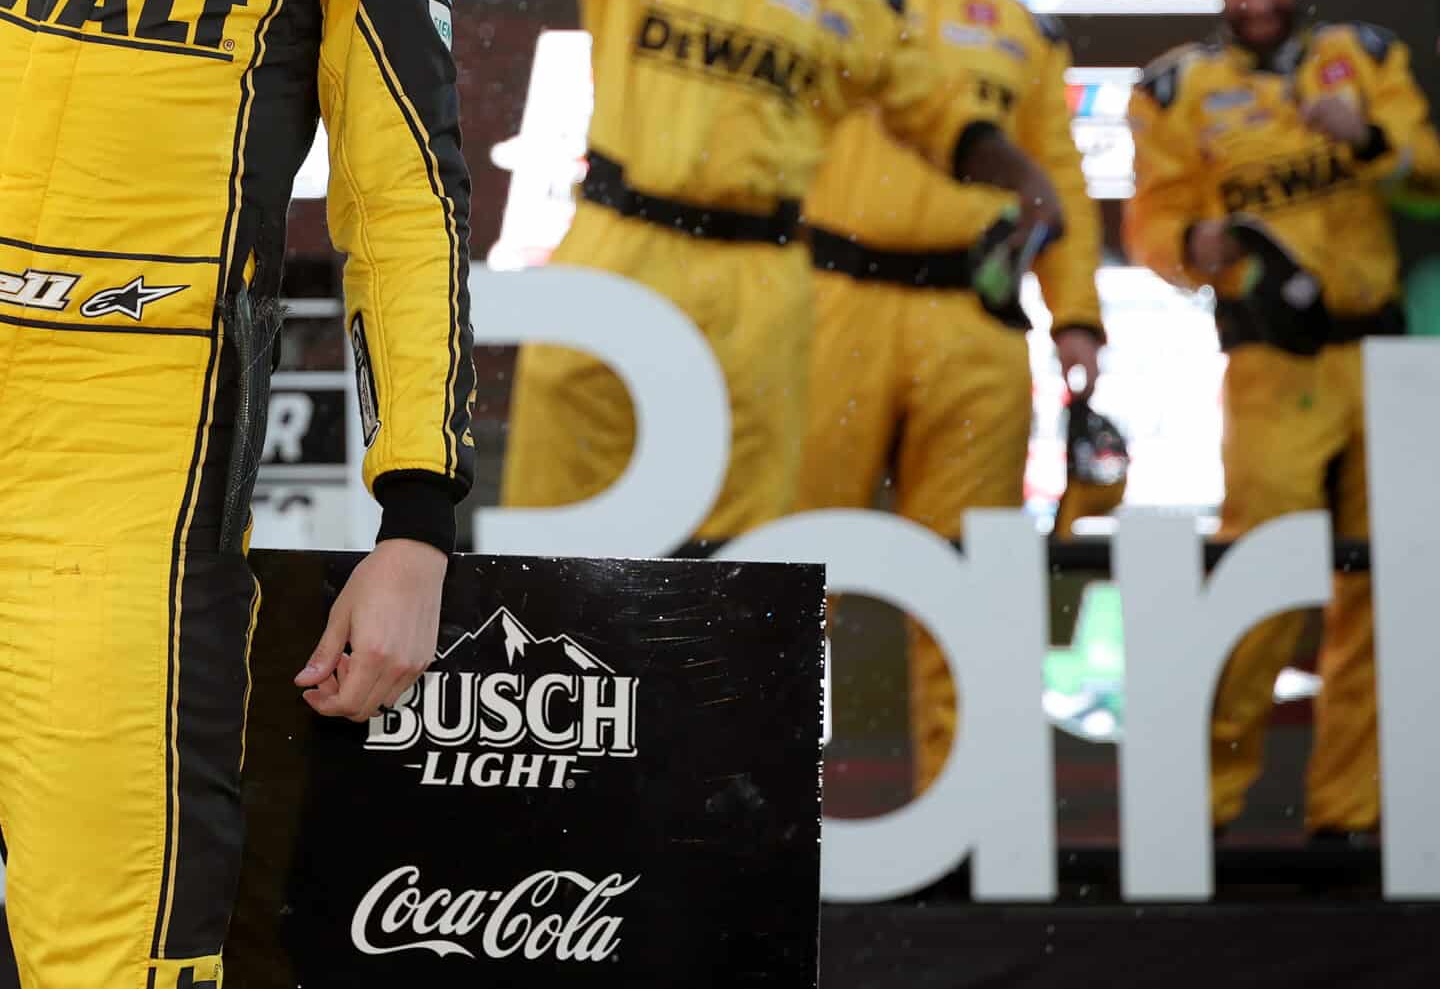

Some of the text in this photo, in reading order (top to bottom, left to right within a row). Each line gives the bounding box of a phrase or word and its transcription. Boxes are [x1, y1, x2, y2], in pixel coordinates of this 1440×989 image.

[363, 671, 640, 757] BUSCH
[420, 751, 577, 788] LIGHT
[351, 865, 641, 962] Coca-Cola
